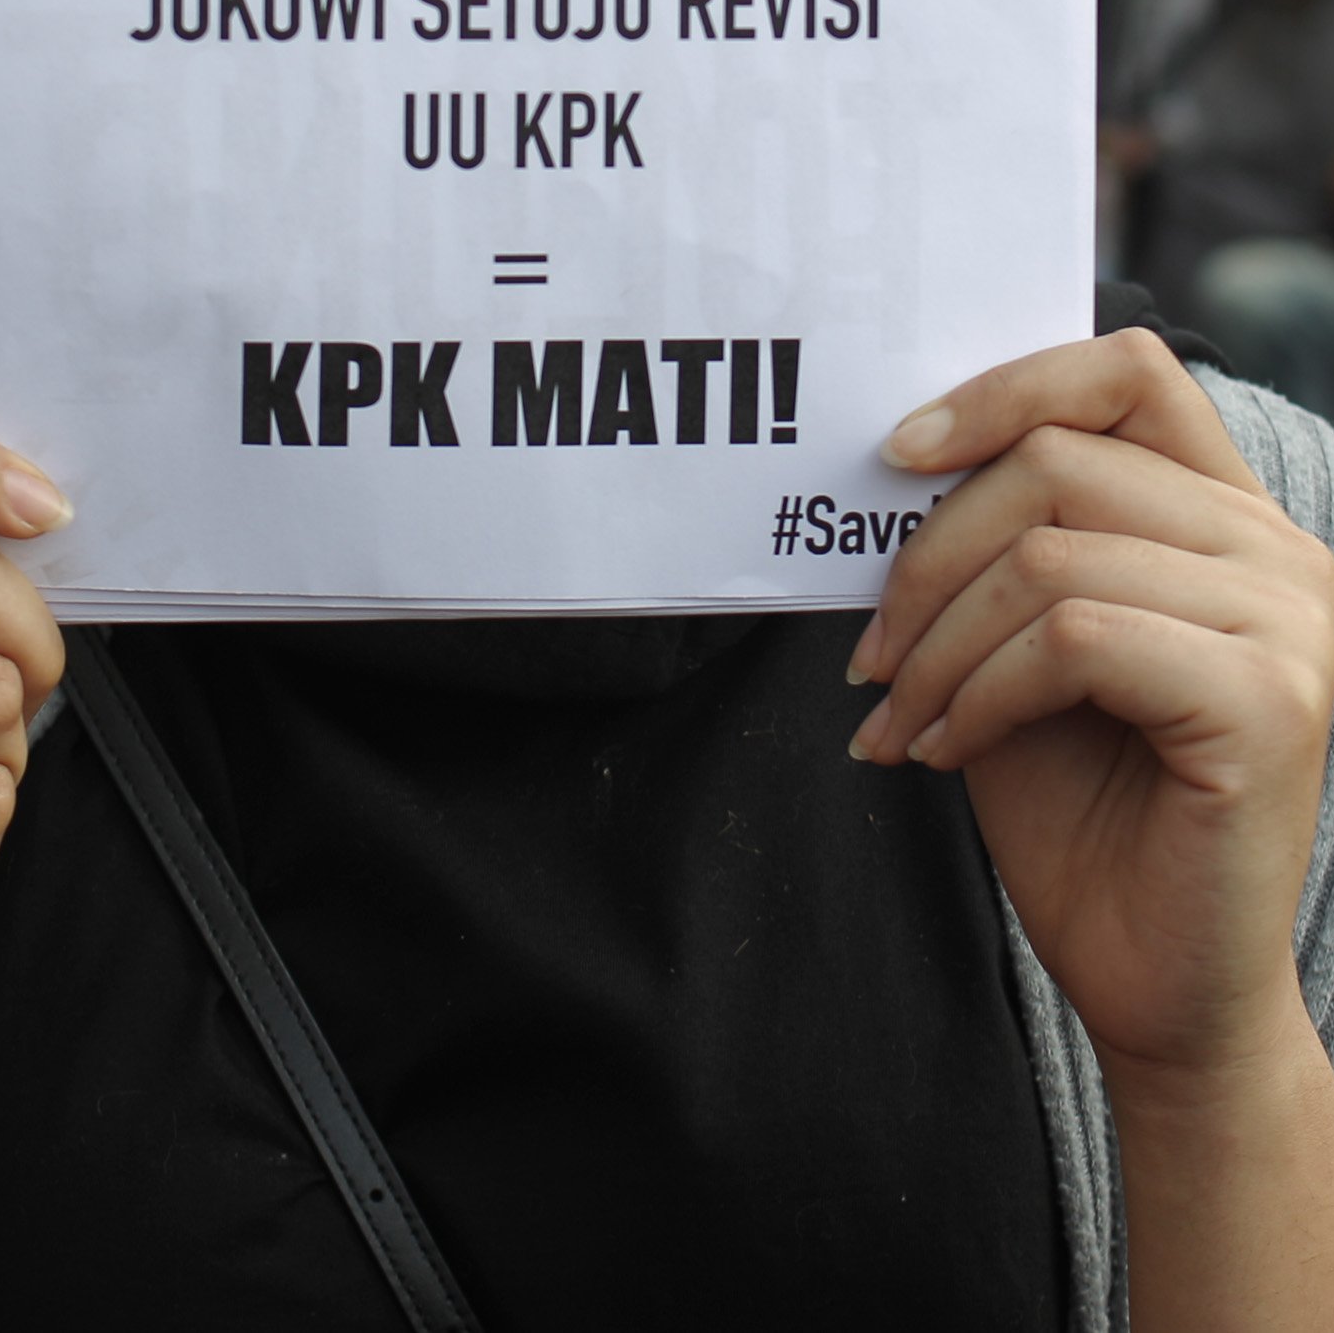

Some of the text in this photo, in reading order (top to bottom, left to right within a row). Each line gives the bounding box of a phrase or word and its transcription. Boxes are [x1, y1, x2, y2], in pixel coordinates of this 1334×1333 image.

[404, 92, 644, 170] UU KPK
[240, 338, 801, 447] KPK MATI!
[772, 495, 943, 556] #Save
